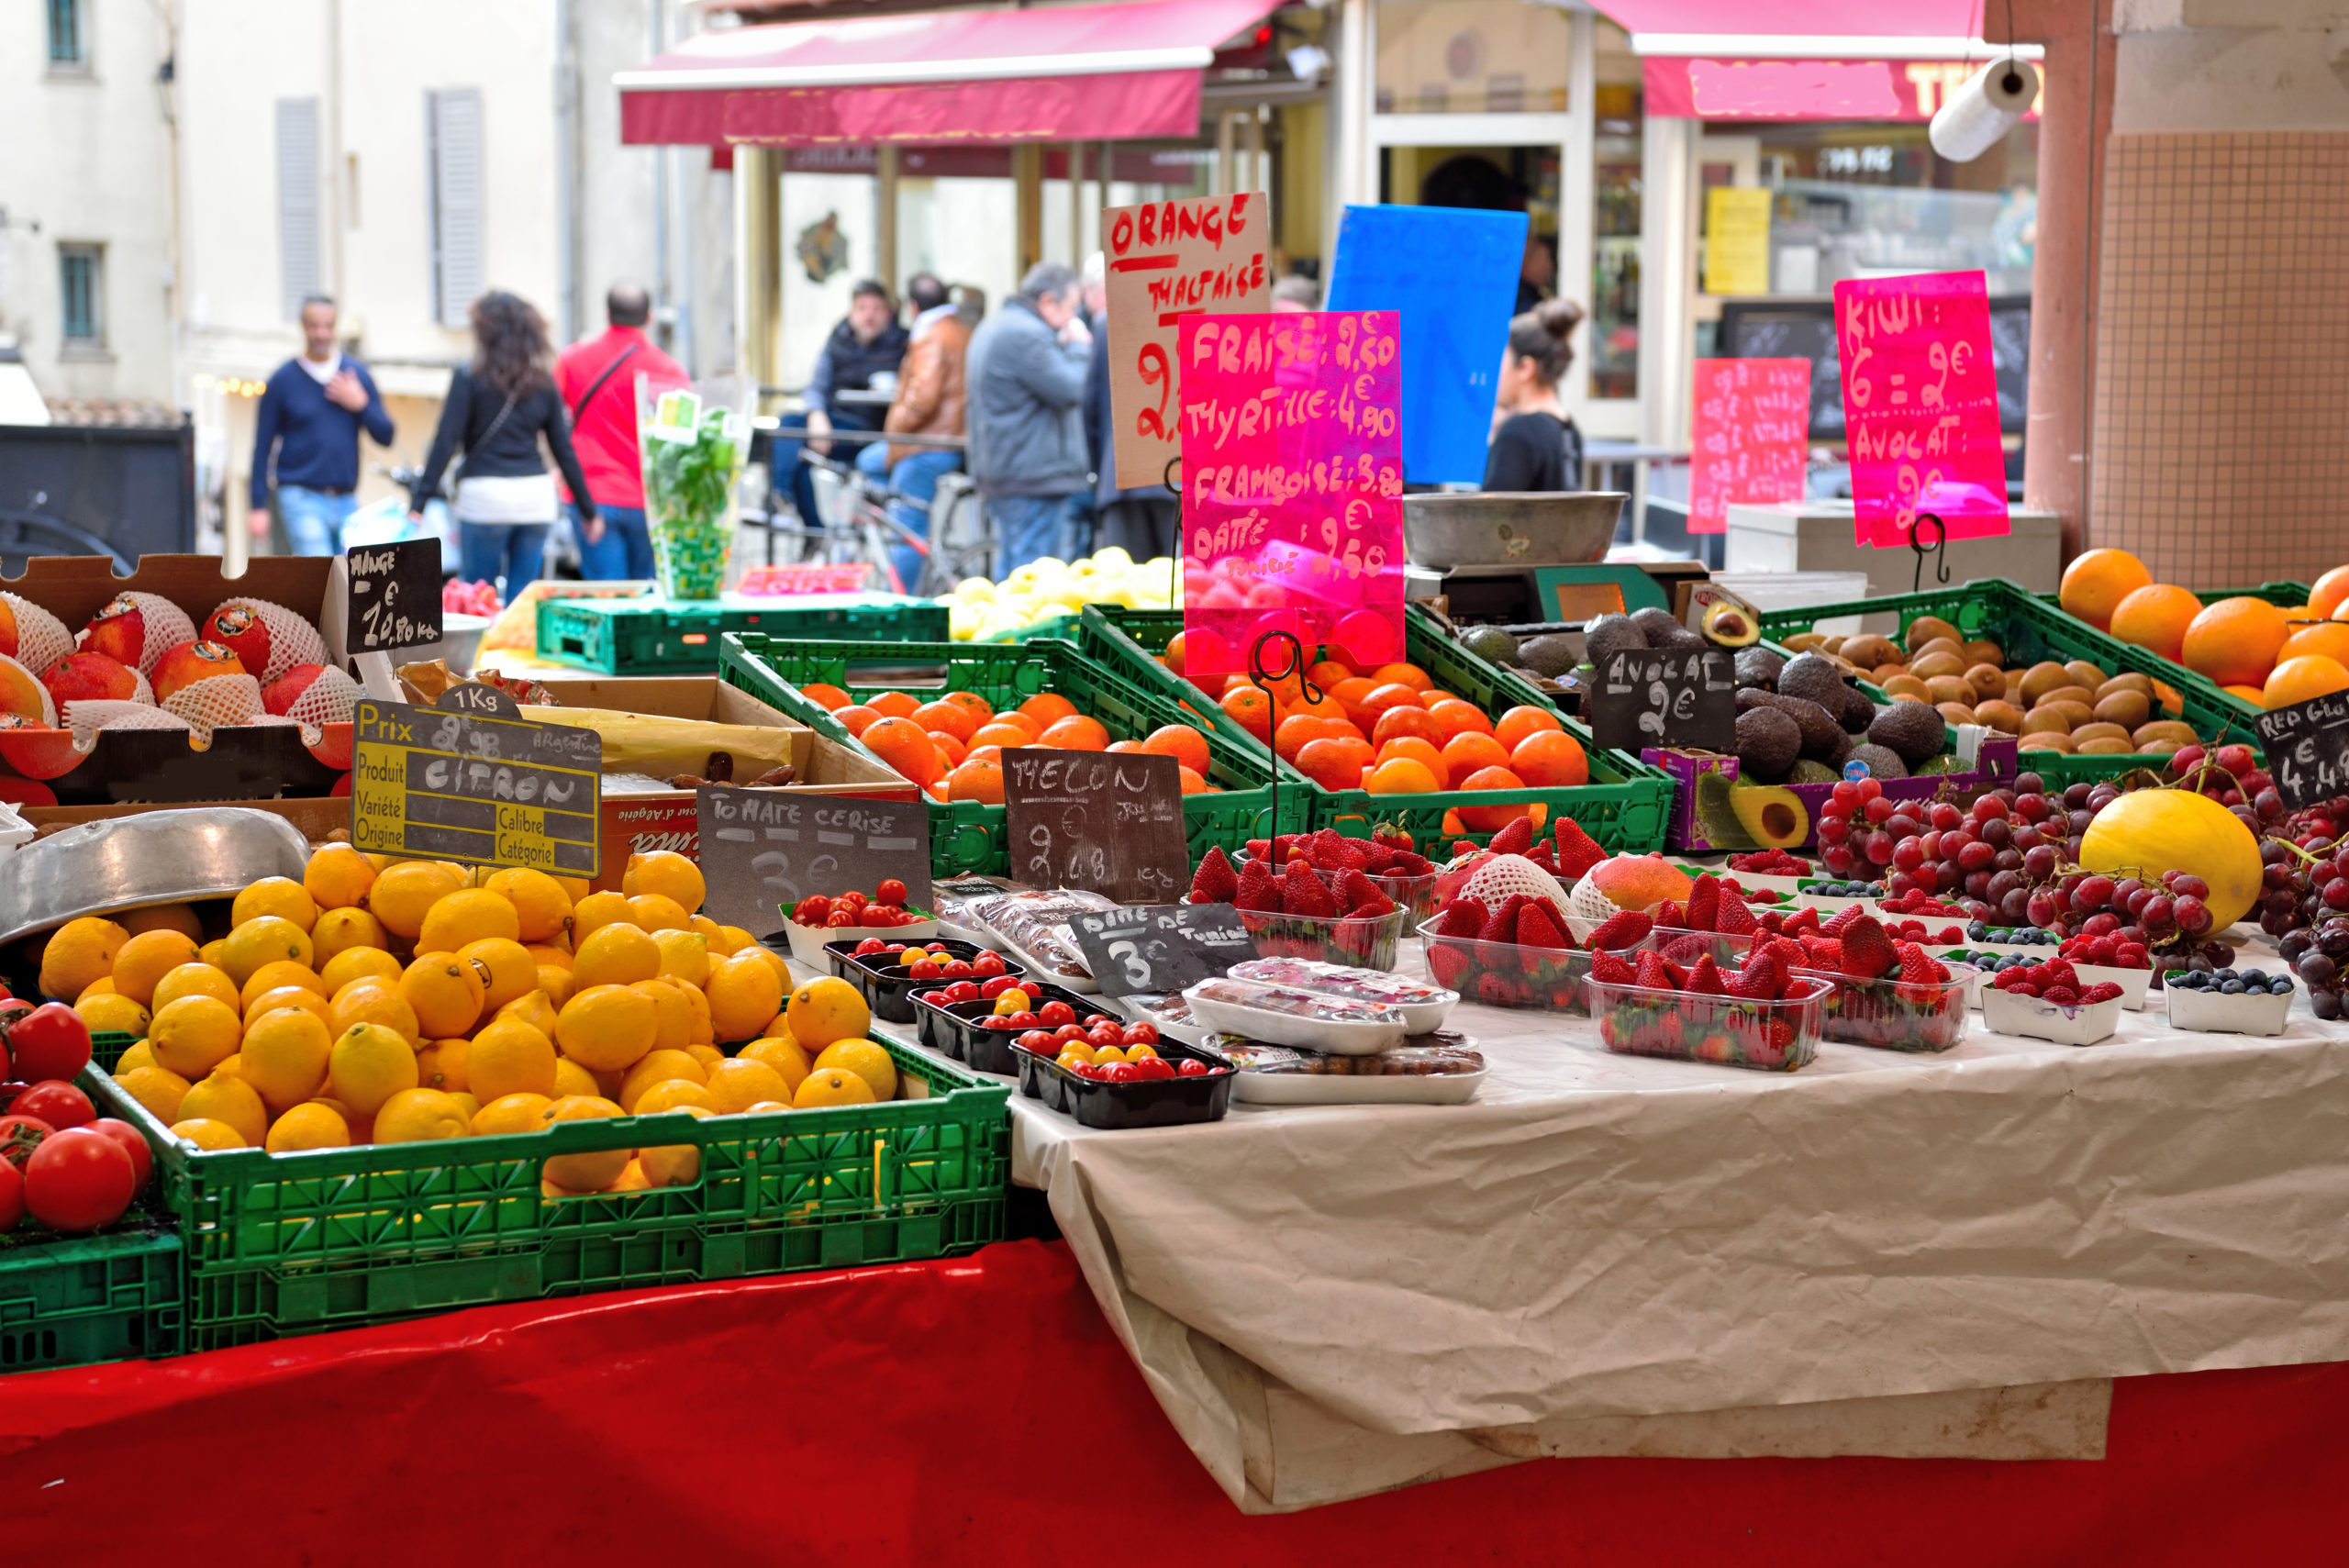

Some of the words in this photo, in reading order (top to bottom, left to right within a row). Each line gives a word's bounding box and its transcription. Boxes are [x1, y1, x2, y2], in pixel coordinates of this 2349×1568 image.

[1111, 193, 1251, 256] ORANGE
[1849, 347, 1873, 408] 6
[1609, 651, 1726, 684] AVOCAT
[359, 703, 413, 742] Prix
[358, 752, 404, 784] Produit
[425, 758, 575, 805] CITRON
[1012, 759, 1150, 794] MELON
[357, 790, 401, 817] Variété
[499, 807, 543, 834] Calibre
[356, 817, 402, 848] Origine
[498, 832, 551, 866] Catégorie
